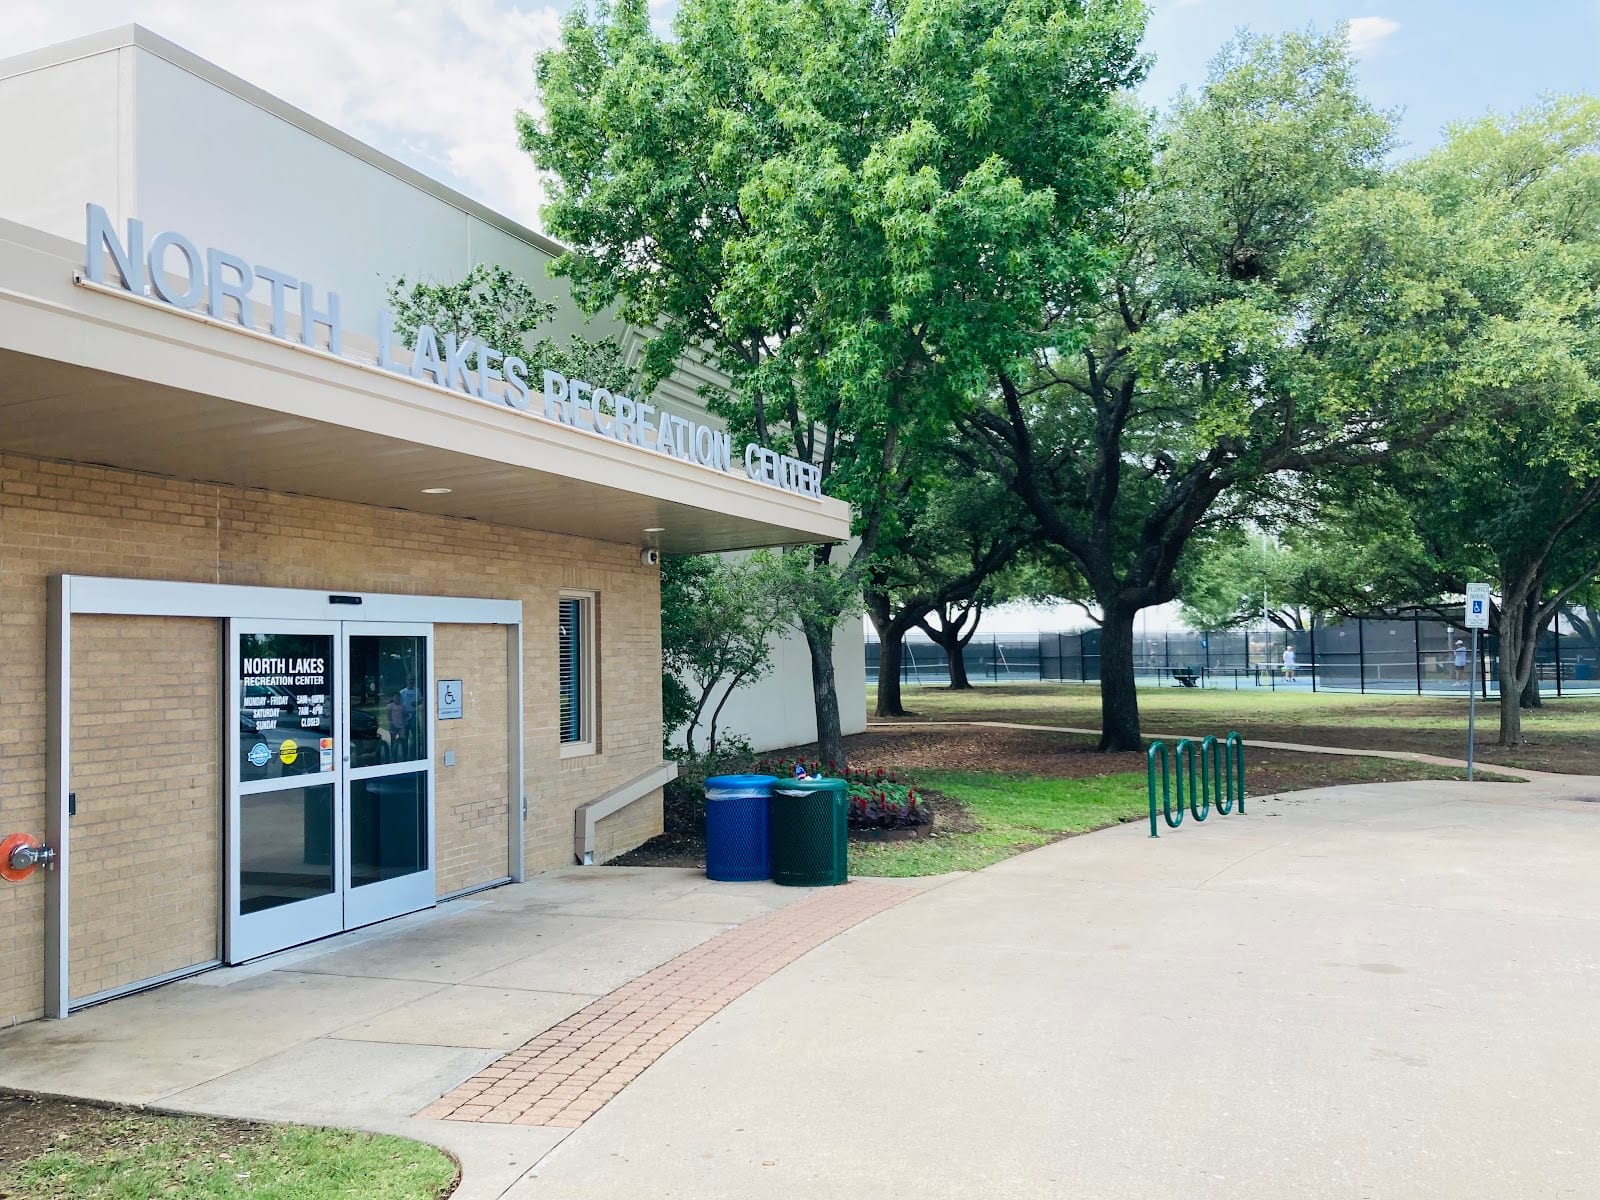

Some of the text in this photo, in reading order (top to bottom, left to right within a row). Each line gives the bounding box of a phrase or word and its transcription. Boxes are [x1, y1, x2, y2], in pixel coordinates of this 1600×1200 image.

[85, 202, 822, 499] NORTH LAKES RECREATION CENTER
[244, 658, 324, 674] NORTH LAKES
[244, 676, 323, 686] RECREATION CENTER
[244, 696, 267, 707] MONDAY
[270, 695, 289, 706] FRIDAY
[253, 708, 280, 718] SATURDAY
[256, 720, 277, 730] SUNDAY
[301, 718, 320, 727] CLOSED
